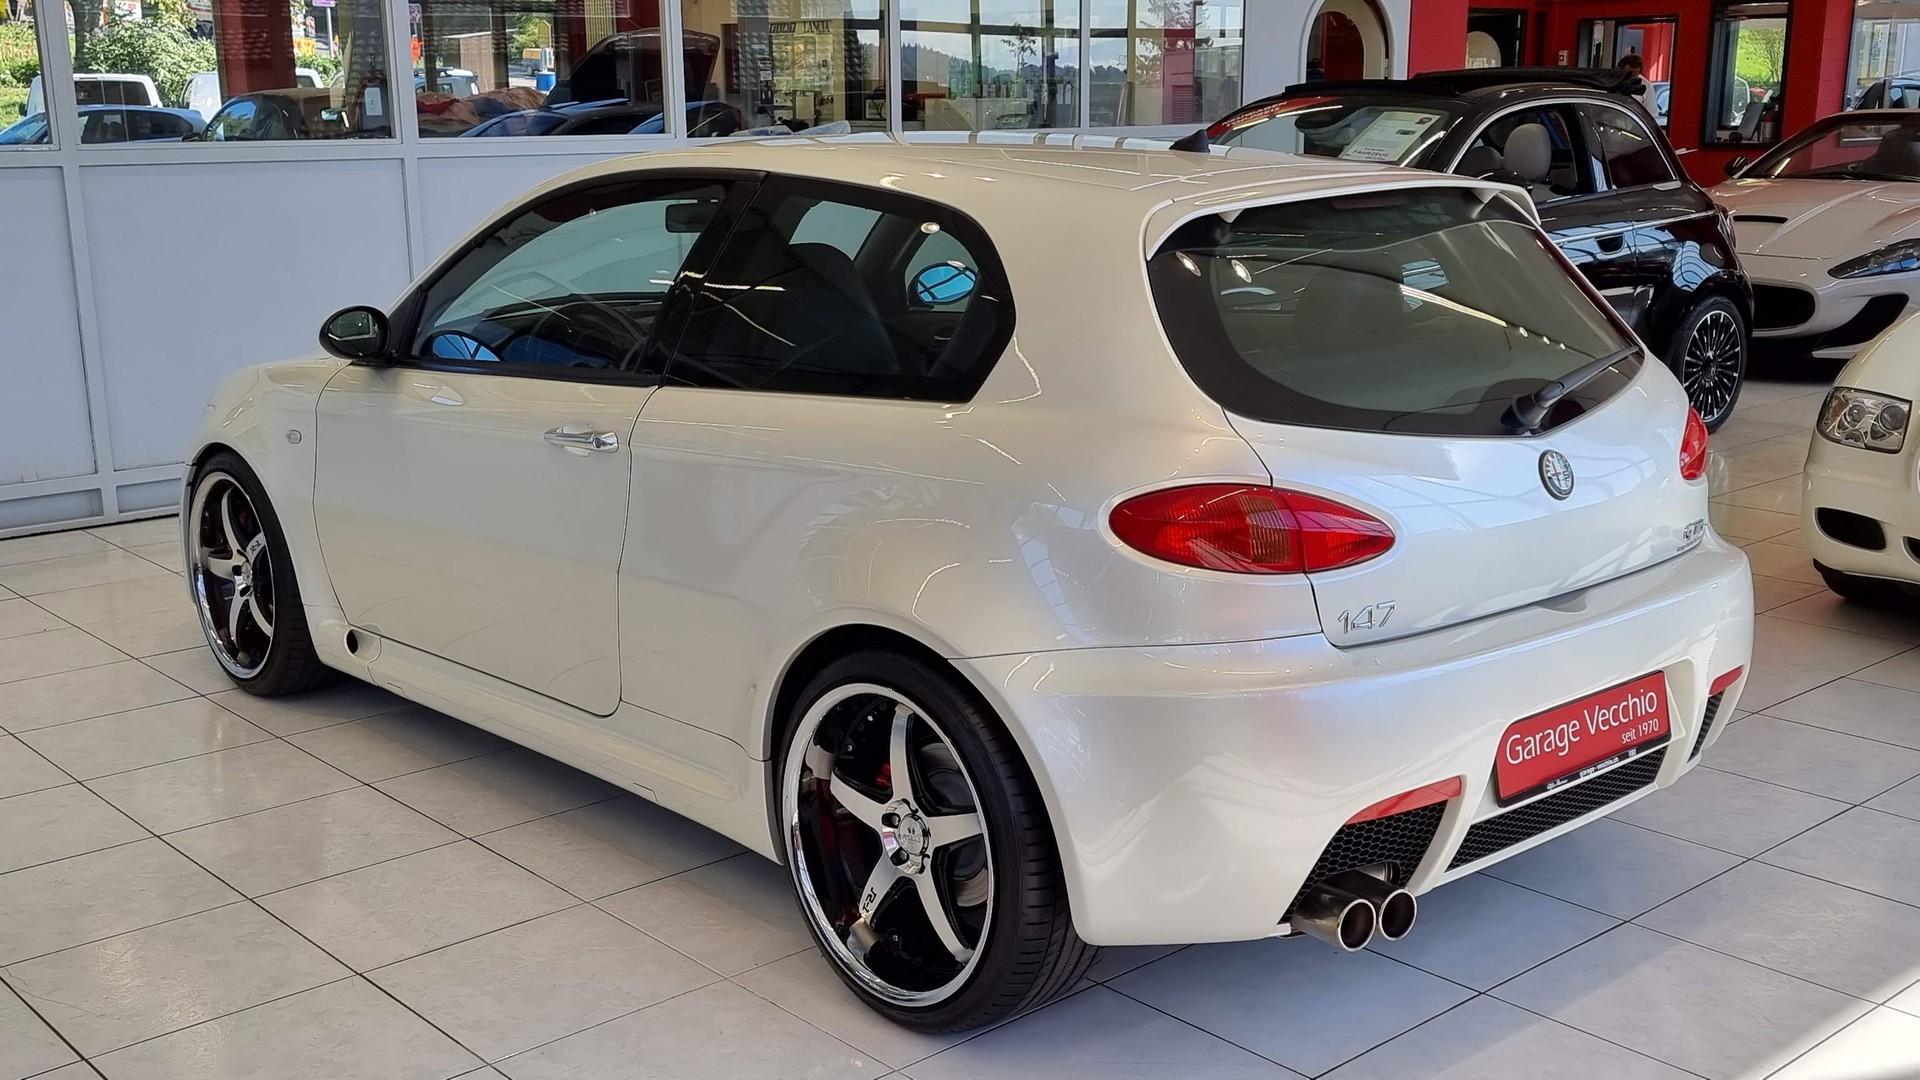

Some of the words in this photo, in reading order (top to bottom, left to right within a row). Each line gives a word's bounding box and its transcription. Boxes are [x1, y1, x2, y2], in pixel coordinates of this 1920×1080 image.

[770, 23, 796, 33] FIAT
[803, 21, 831, 33] LANCIA
[1337, 599, 1396, 634] 147
[1505, 718, 1580, 765] Garage
[1584, 688, 1658, 735] Vecchio
[1621, 727, 1637, 744] seit
[1638, 718, 1659, 738] 1970
